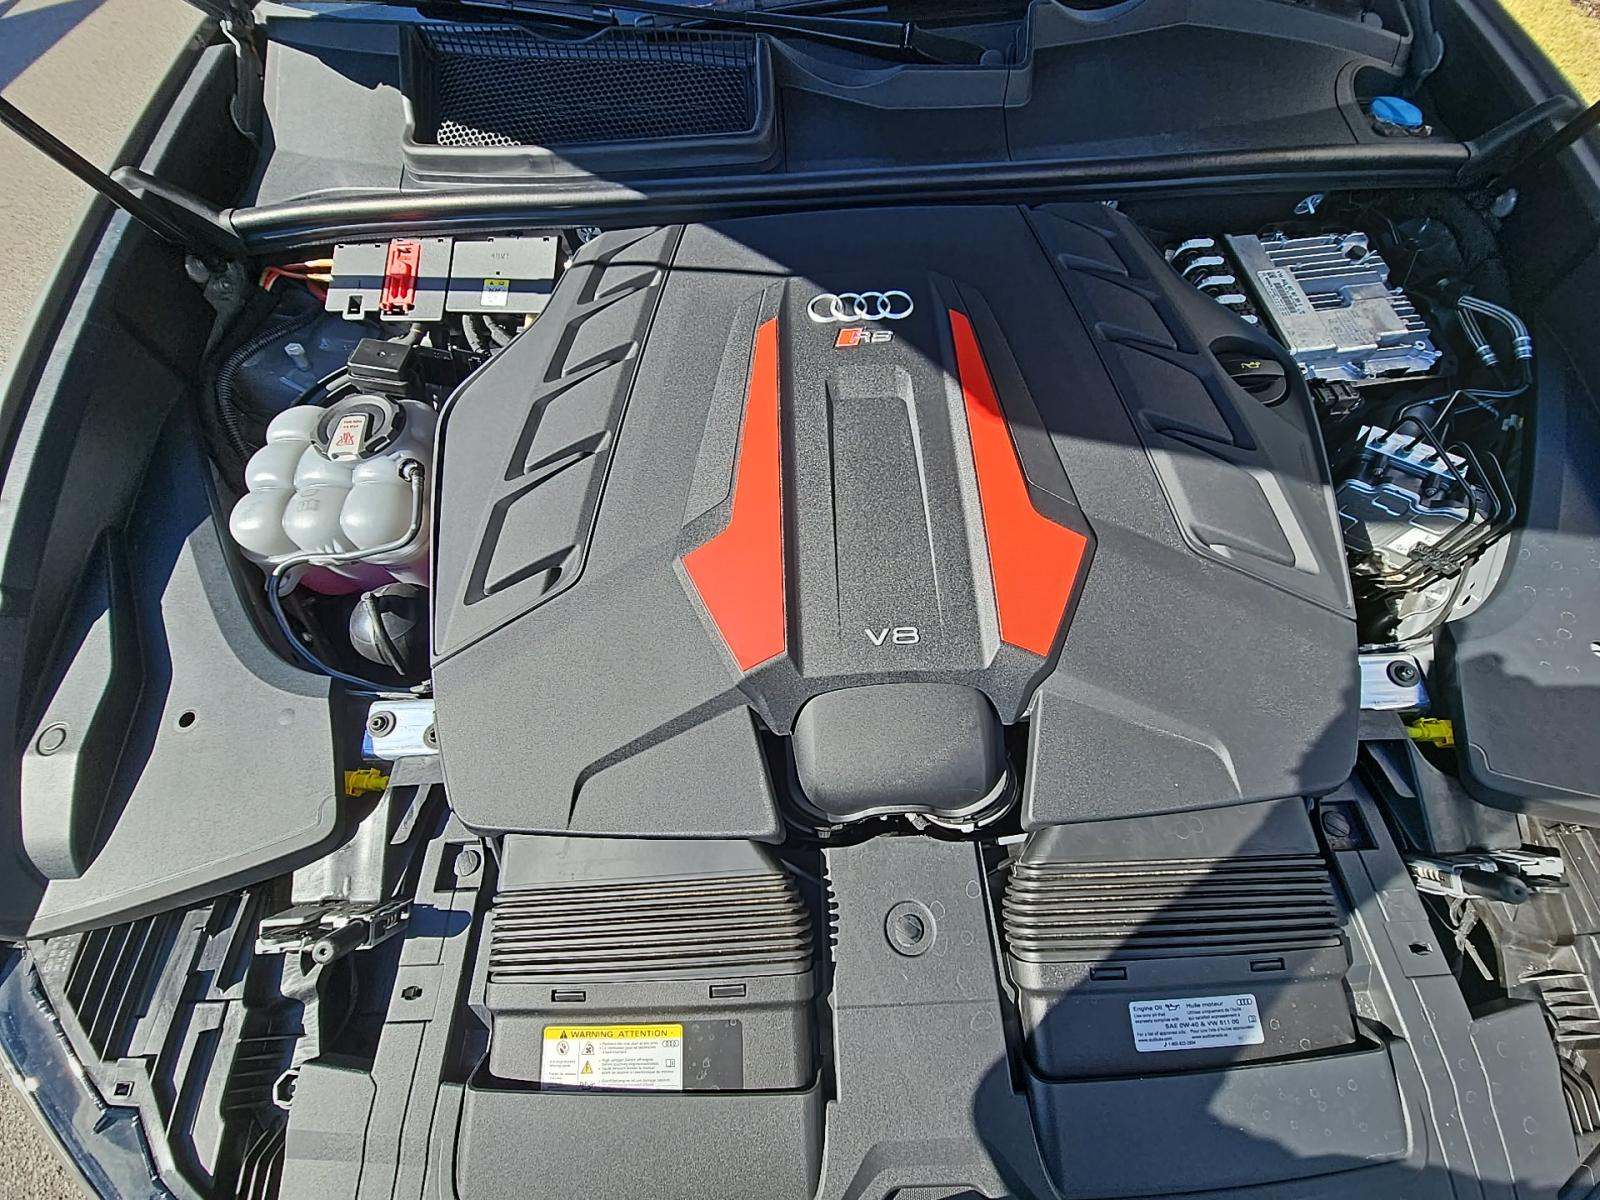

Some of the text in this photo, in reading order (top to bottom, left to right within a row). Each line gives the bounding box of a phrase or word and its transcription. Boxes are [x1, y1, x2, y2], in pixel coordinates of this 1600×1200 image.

[843, 328, 894, 347] RS
[864, 627, 920, 646] V8
[570, 1030, 668, 1038] WARNING ATTENTION
